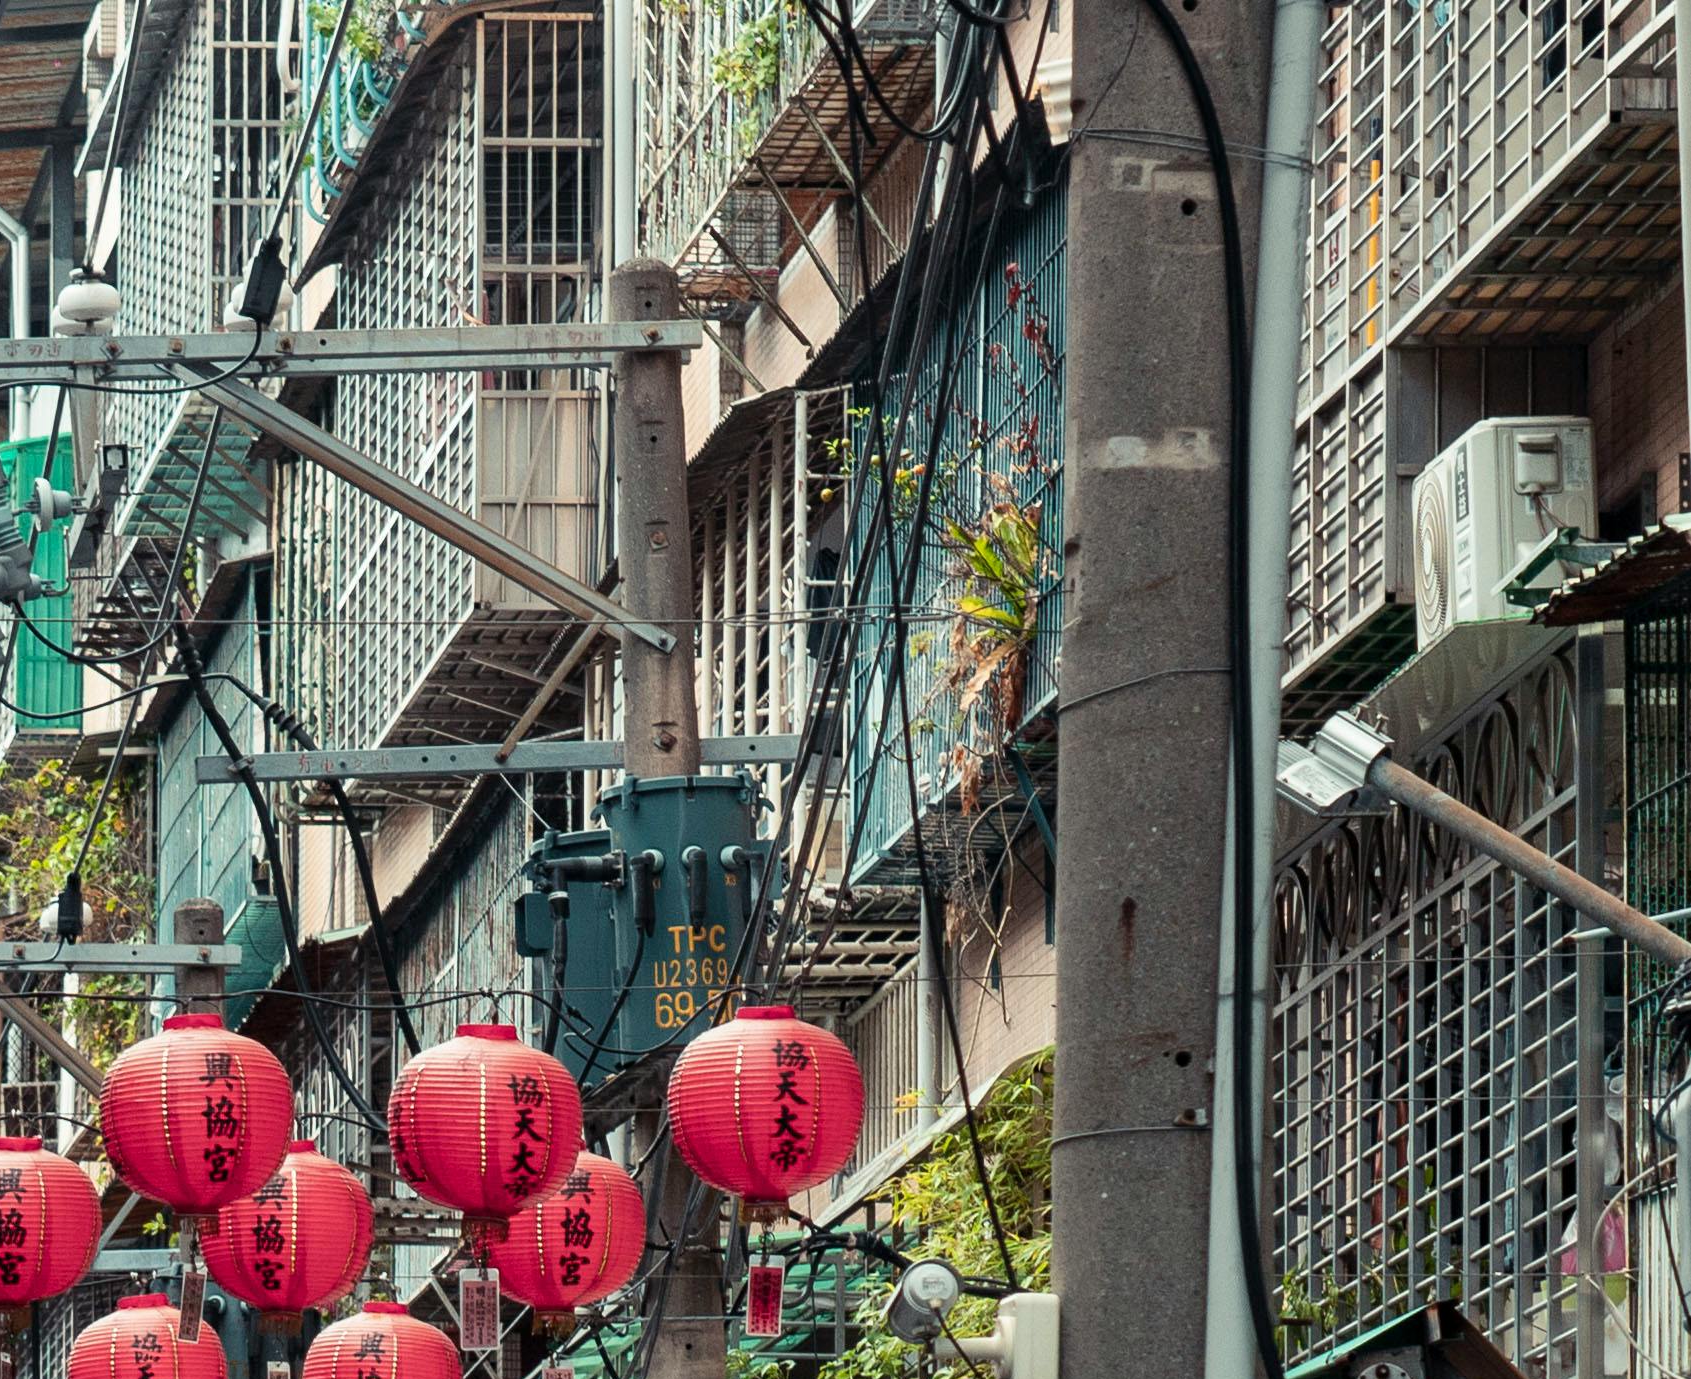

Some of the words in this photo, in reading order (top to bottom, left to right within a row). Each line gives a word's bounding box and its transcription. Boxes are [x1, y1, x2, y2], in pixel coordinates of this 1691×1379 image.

[668, 925, 727, 953] TPC
[199, 1053, 242, 1185] 興協宮
[507, 1074, 544, 1199] 協天大帝
[771, 1040, 809, 1171] 協天大帝
[252, 1173, 289, 1292] 興協宮
[560, 1170, 595, 1286] 興協宮
